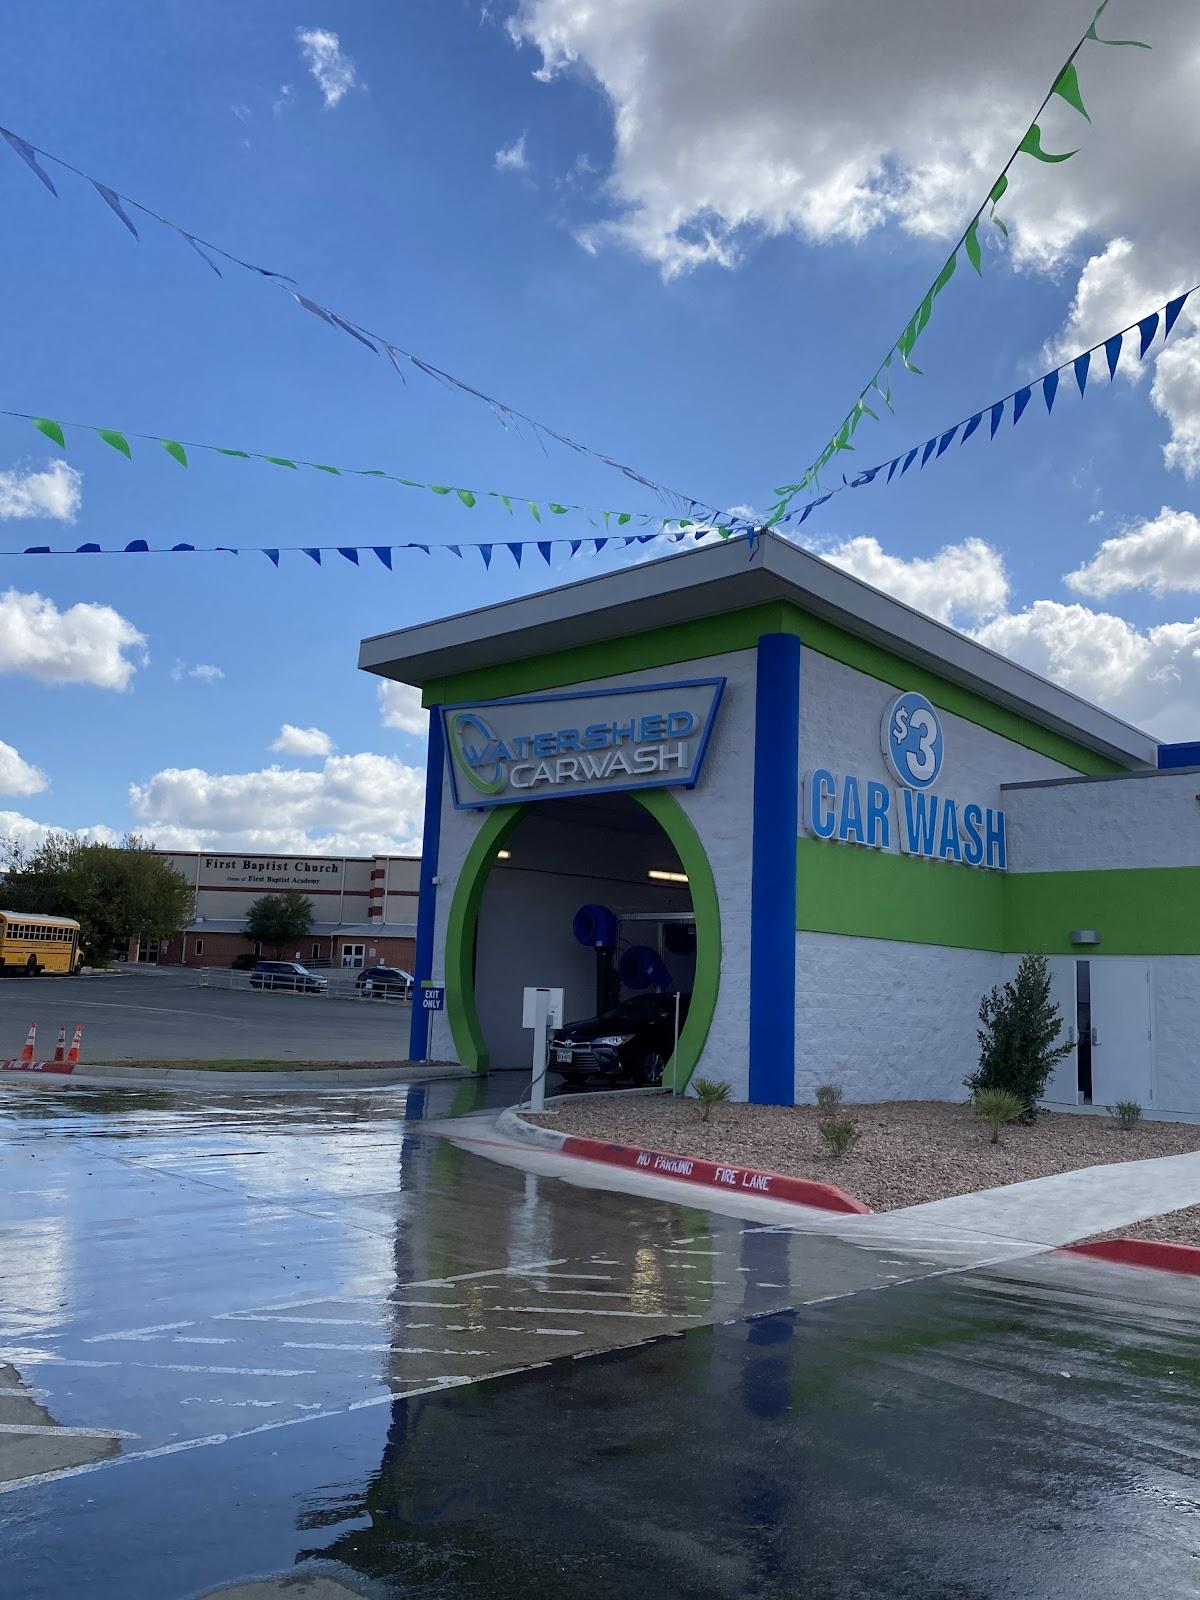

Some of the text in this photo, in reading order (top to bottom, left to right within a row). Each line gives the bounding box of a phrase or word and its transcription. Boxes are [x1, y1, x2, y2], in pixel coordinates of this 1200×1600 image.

[462, 711, 695, 767] WATERSHED
[892, 706, 937, 781] $3
[510, 742, 688, 788] CARWASH
[808, 767, 1007, 869] CAR WASH
[206, 859, 339, 873] First Baptist Church
[267, 876, 290, 884] Baptist
[292, 877, 320, 885] Academy
[423, 999, 440, 1008] ONLY
[425, 990, 439, 999] EXIT
[637, 1152, 772, 1191] NO PARKING FIRE LANE
